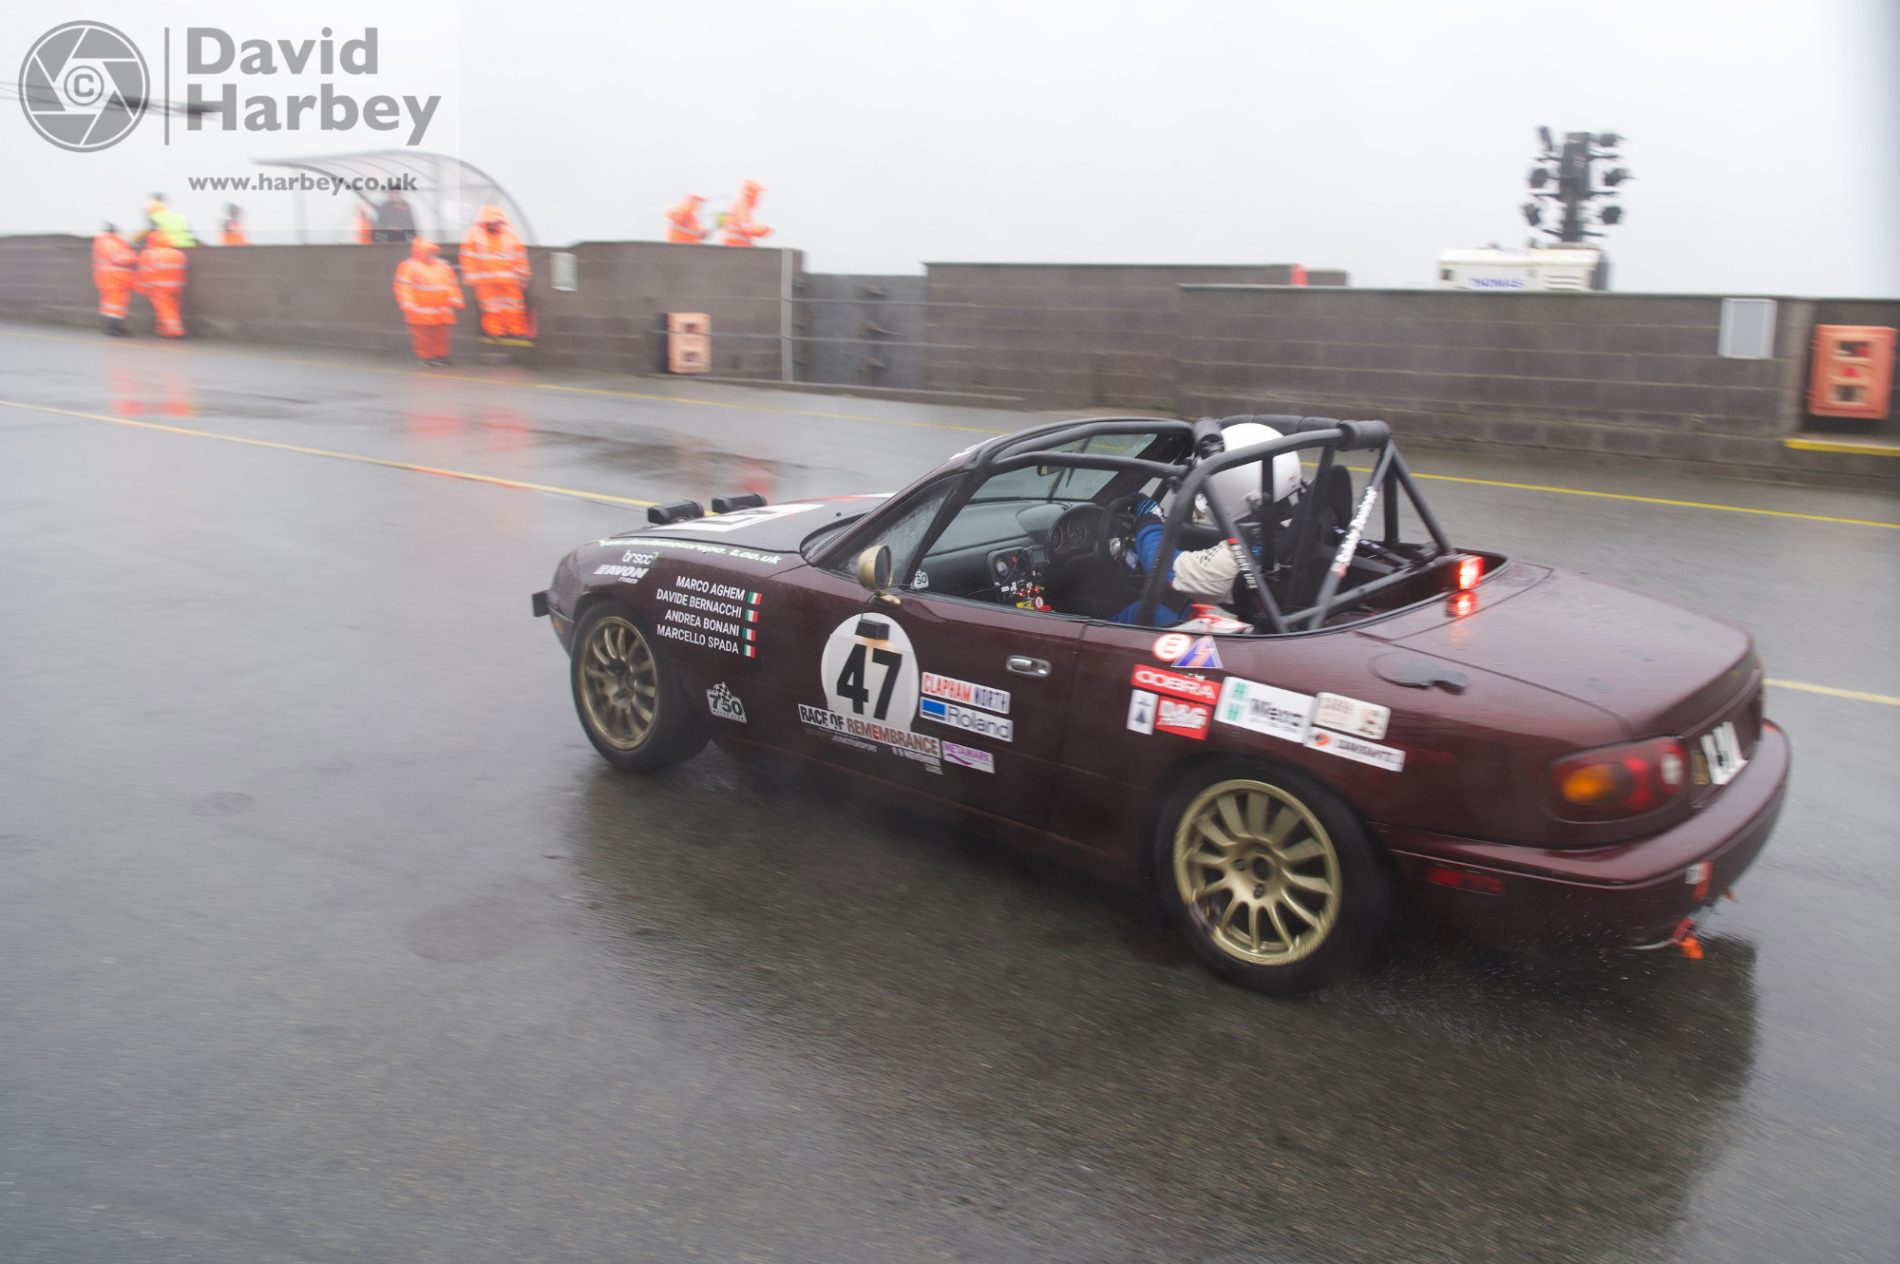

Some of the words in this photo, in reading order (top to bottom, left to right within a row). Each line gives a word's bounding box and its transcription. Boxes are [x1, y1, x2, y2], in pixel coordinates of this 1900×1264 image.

[656, 588, 689, 607] DAVIDE
[688, 596, 743, 619] BERNACCHI
[676, 576, 710, 594] MARCO
[709, 583, 746, 602] AGHEM
[664, 609, 702, 628] ANDREA
[703, 617, 740, 637] BONANI
[656, 624, 706, 646] MARCELLO
[707, 636, 740, 655] SPADA
[836, 643, 903, 721] 47
[1135, 670, 1216, 699] COBRA
[709, 693, 743, 716] 750
[800, 706, 828, 726] RACE
[829, 713, 845, 730] OF
[846, 717, 939, 755] REMEMBRANCE
[948, 705, 1011, 738] Roland
